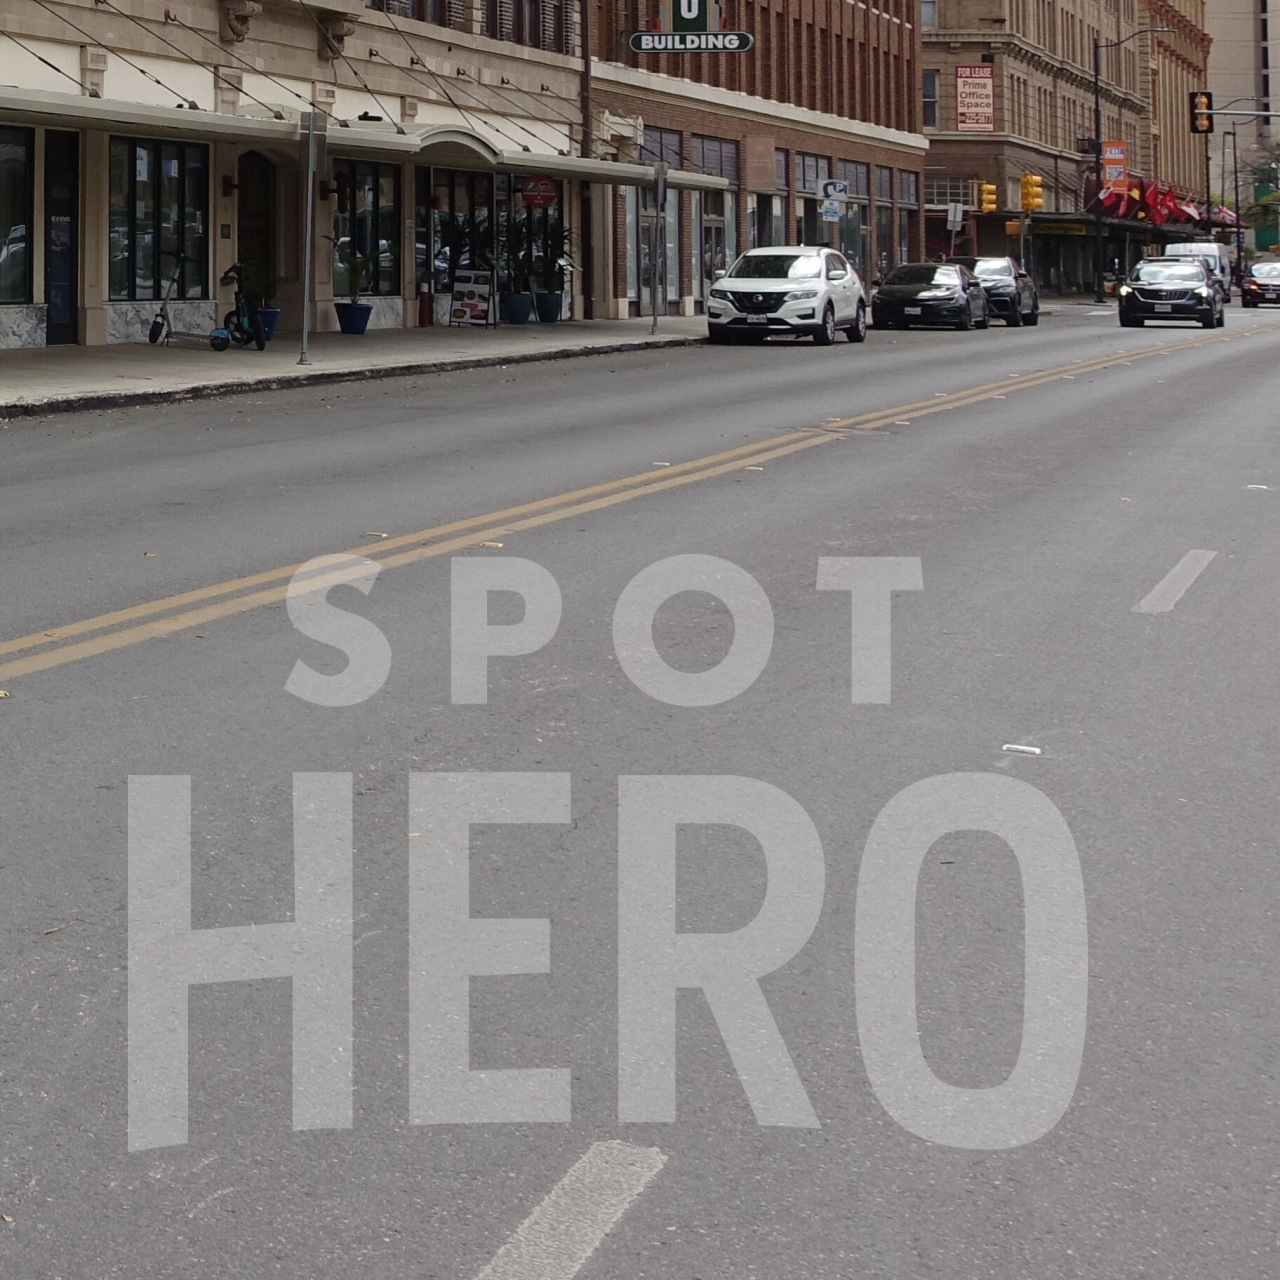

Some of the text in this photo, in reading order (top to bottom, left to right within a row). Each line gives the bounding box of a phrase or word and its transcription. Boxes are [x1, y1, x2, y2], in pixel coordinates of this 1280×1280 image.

[641, 35, 740, 50] BUILDING
[957, 67, 992, 77] FOR LEASE
[963, 80, 987, 89] Prime
[960, 91, 991, 99] Office
[959, 100, 991, 109] Space
